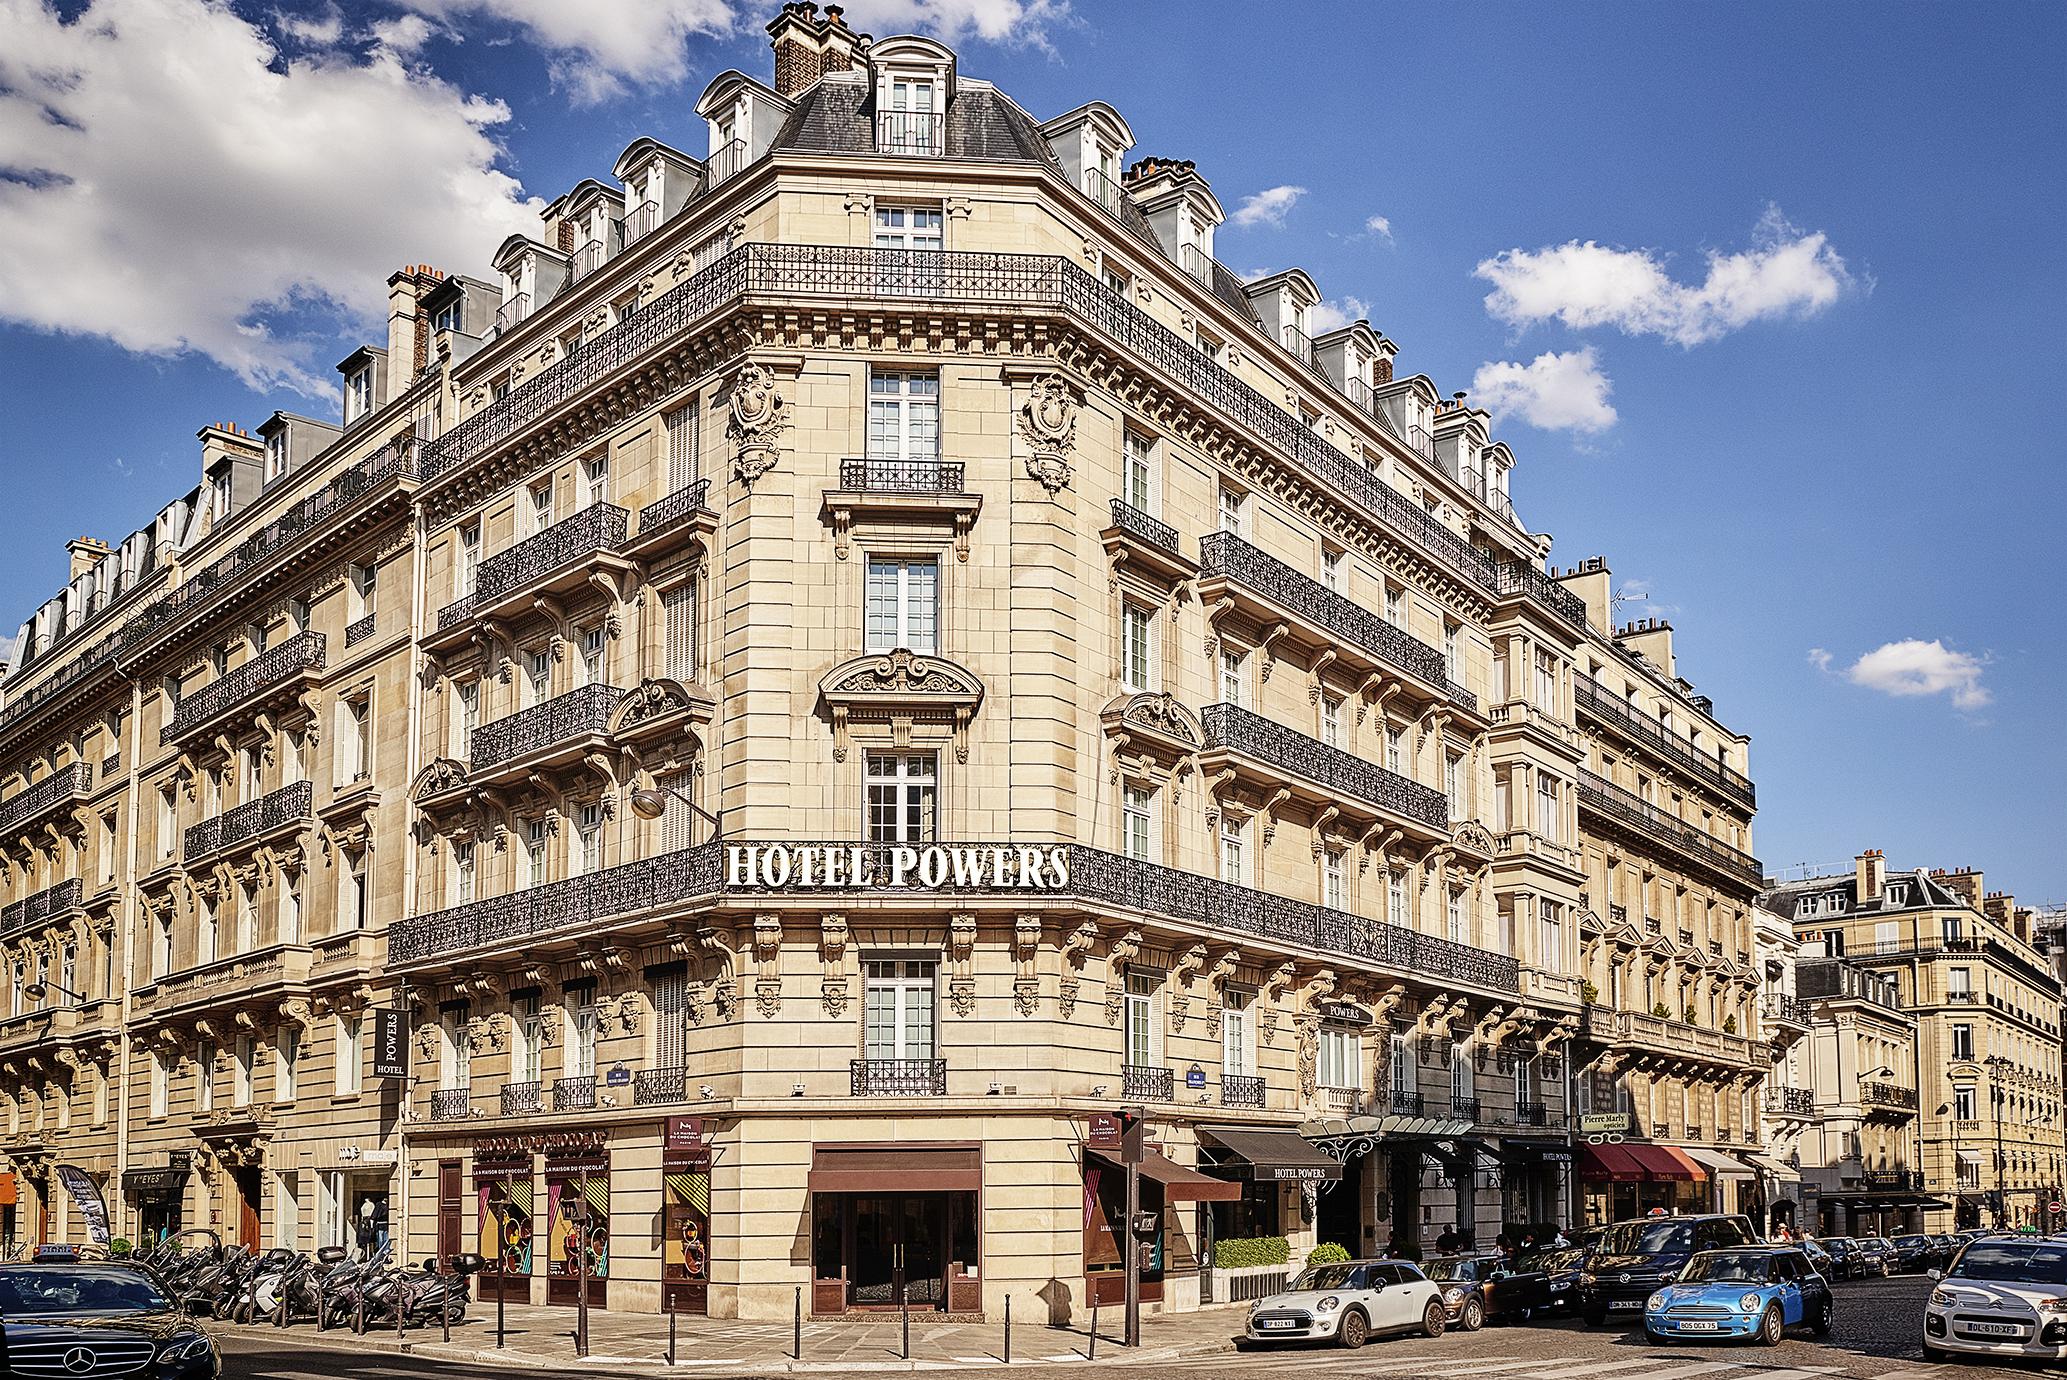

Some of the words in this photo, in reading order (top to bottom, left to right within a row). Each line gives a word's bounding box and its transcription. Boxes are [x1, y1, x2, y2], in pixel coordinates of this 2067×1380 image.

[726, 845, 873, 887] HOTEL
[888, 845, 1070, 888] POWERS
[1330, 1006, 1359, 1019] POWERS
[386, 1014, 398, 1061] POWERS
[377, 1065, 404, 1074] HOTEL
[1584, 1115, 1604, 1124] Pierre
[1606, 1114, 1625, 1122] Marly
[1274, 1168, 1297, 1178] HOTEL
[1298, 1168, 1326, 1178] POWERS
